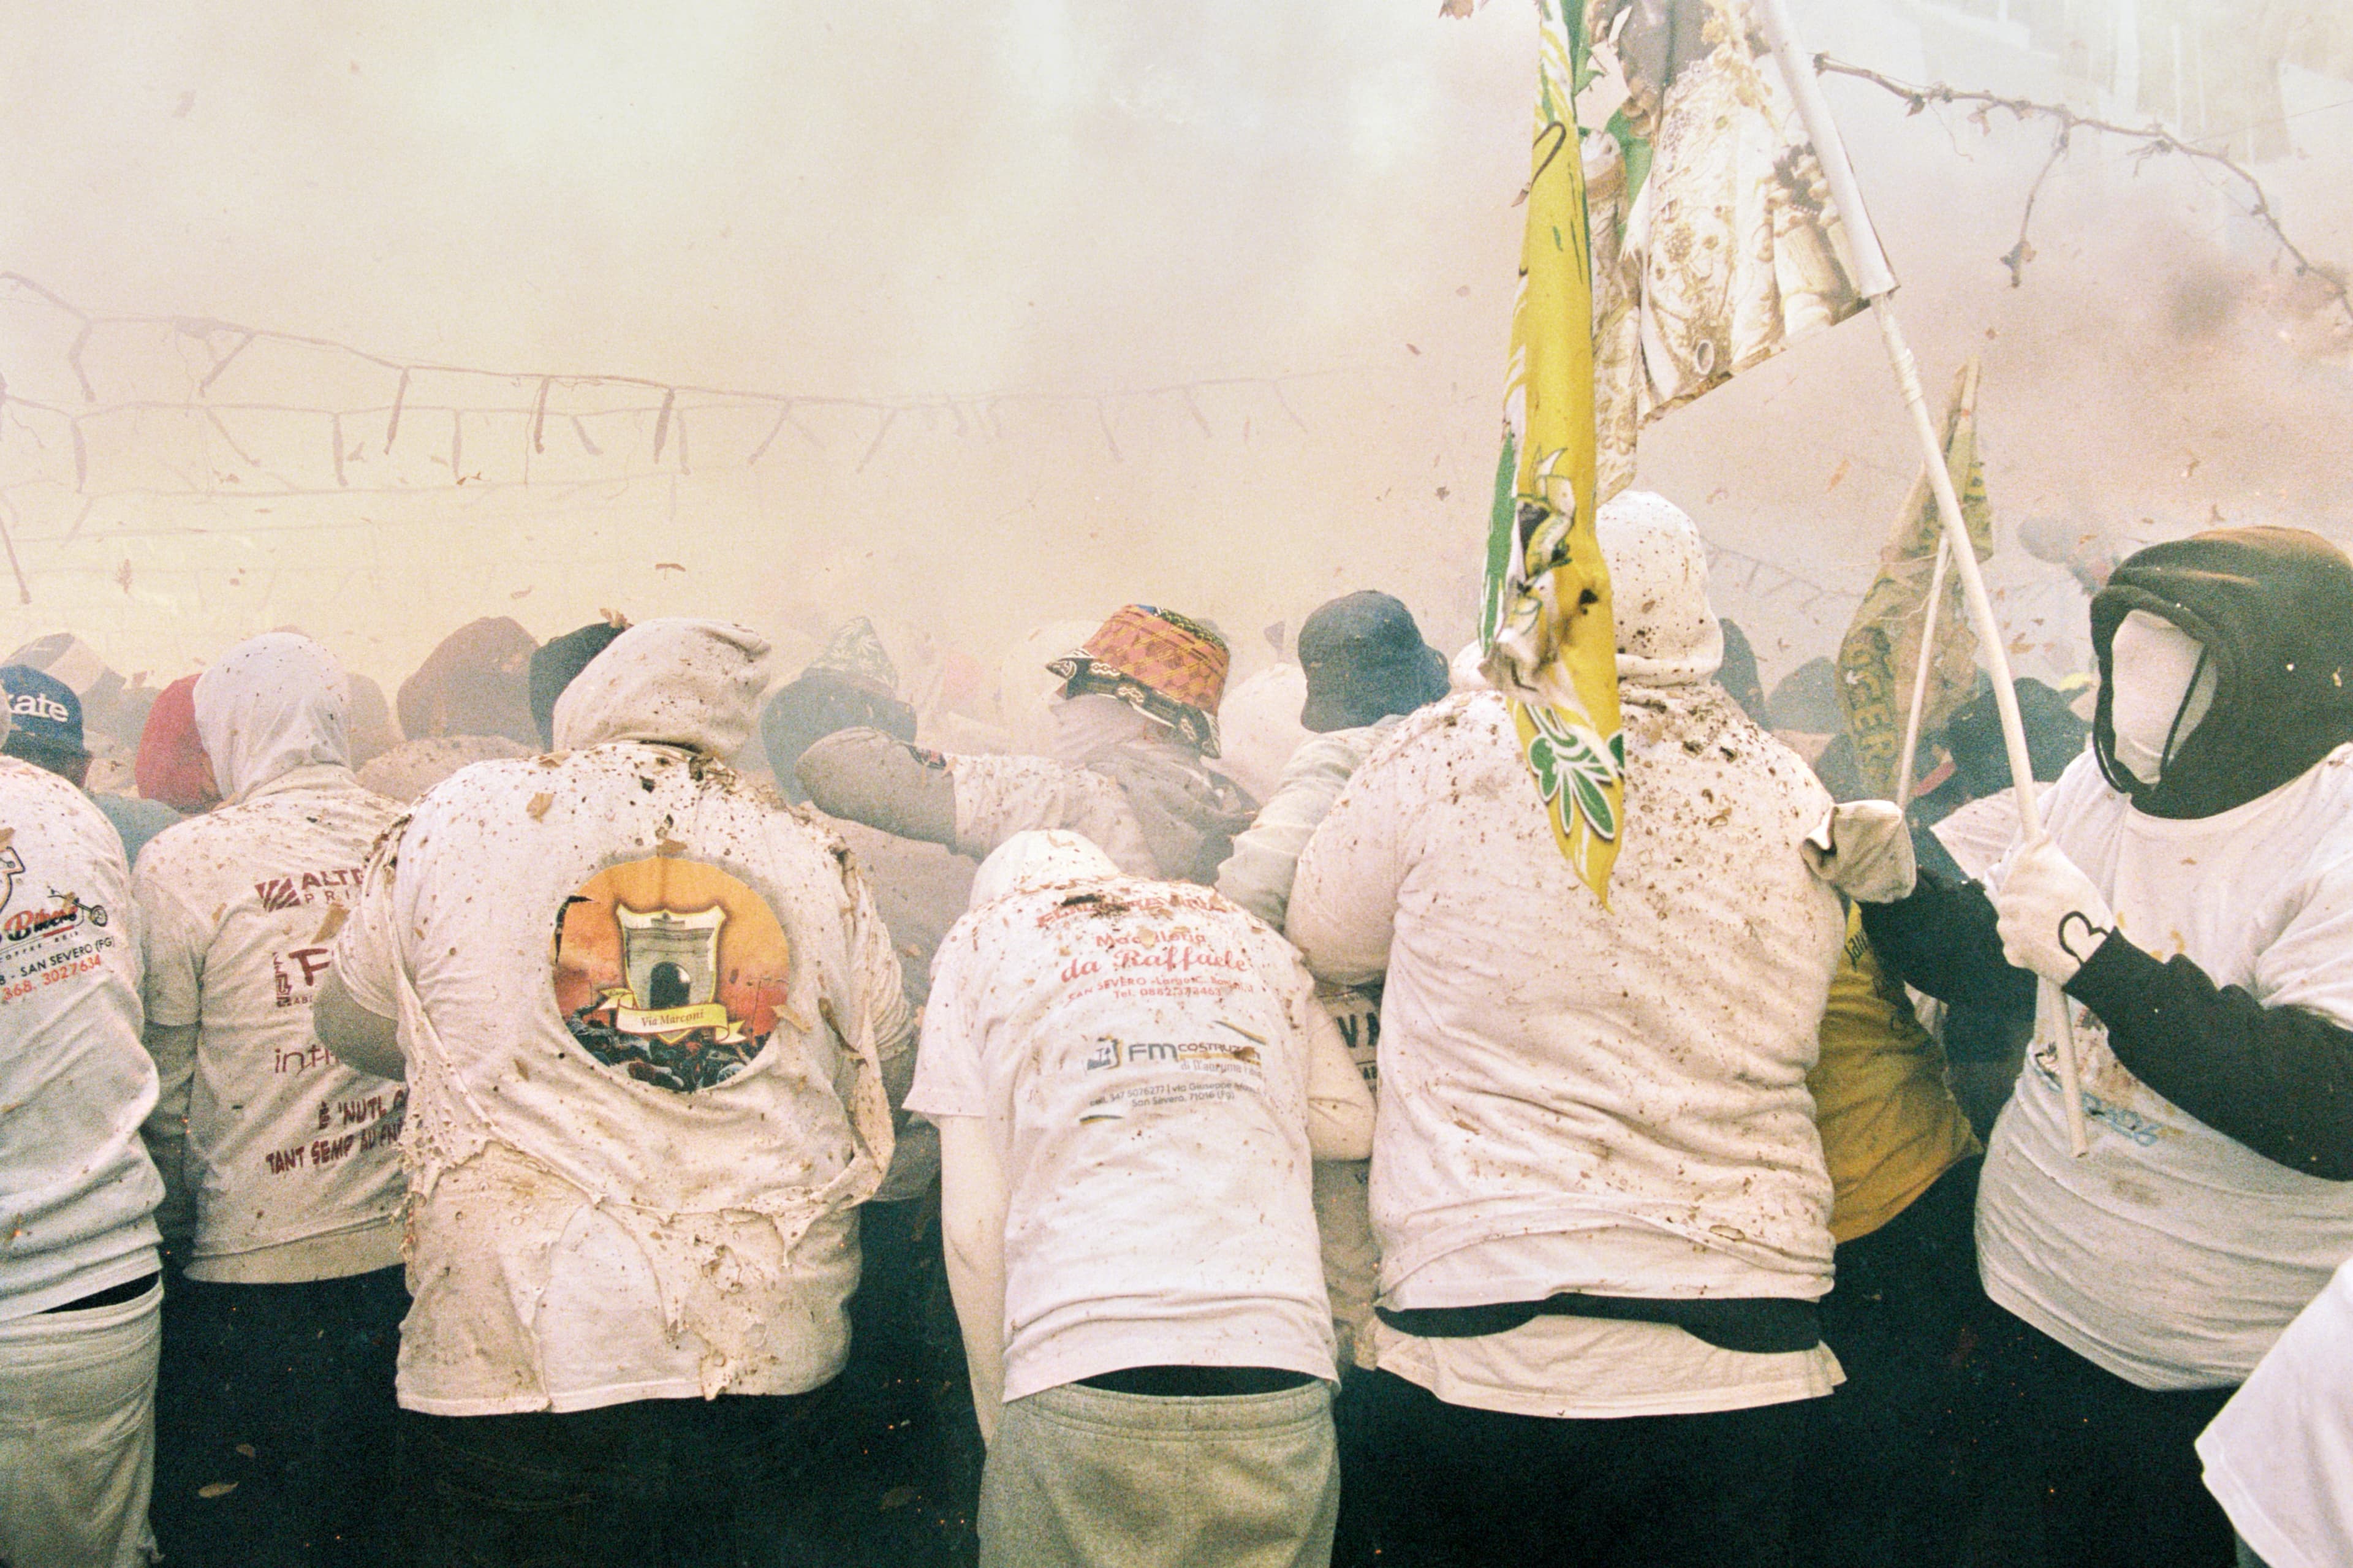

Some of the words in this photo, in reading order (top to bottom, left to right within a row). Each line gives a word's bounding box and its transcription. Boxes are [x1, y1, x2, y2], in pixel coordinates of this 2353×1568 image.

[20, 960, 47, 977] SAN
[49, 944, 93, 966] SEVERO
[96, 936, 116, 953] (FG)
[42, 953, 102, 985] 3027634
[1061, 957, 1102, 983] da
[1111, 945, 1248, 972] Raffaele
[641, 1015, 657, 1026] Via
[660, 1009, 704, 1026] Marconi
[266, 1146, 305, 1175] TANT
[311, 1134, 354, 1165] SEMP
